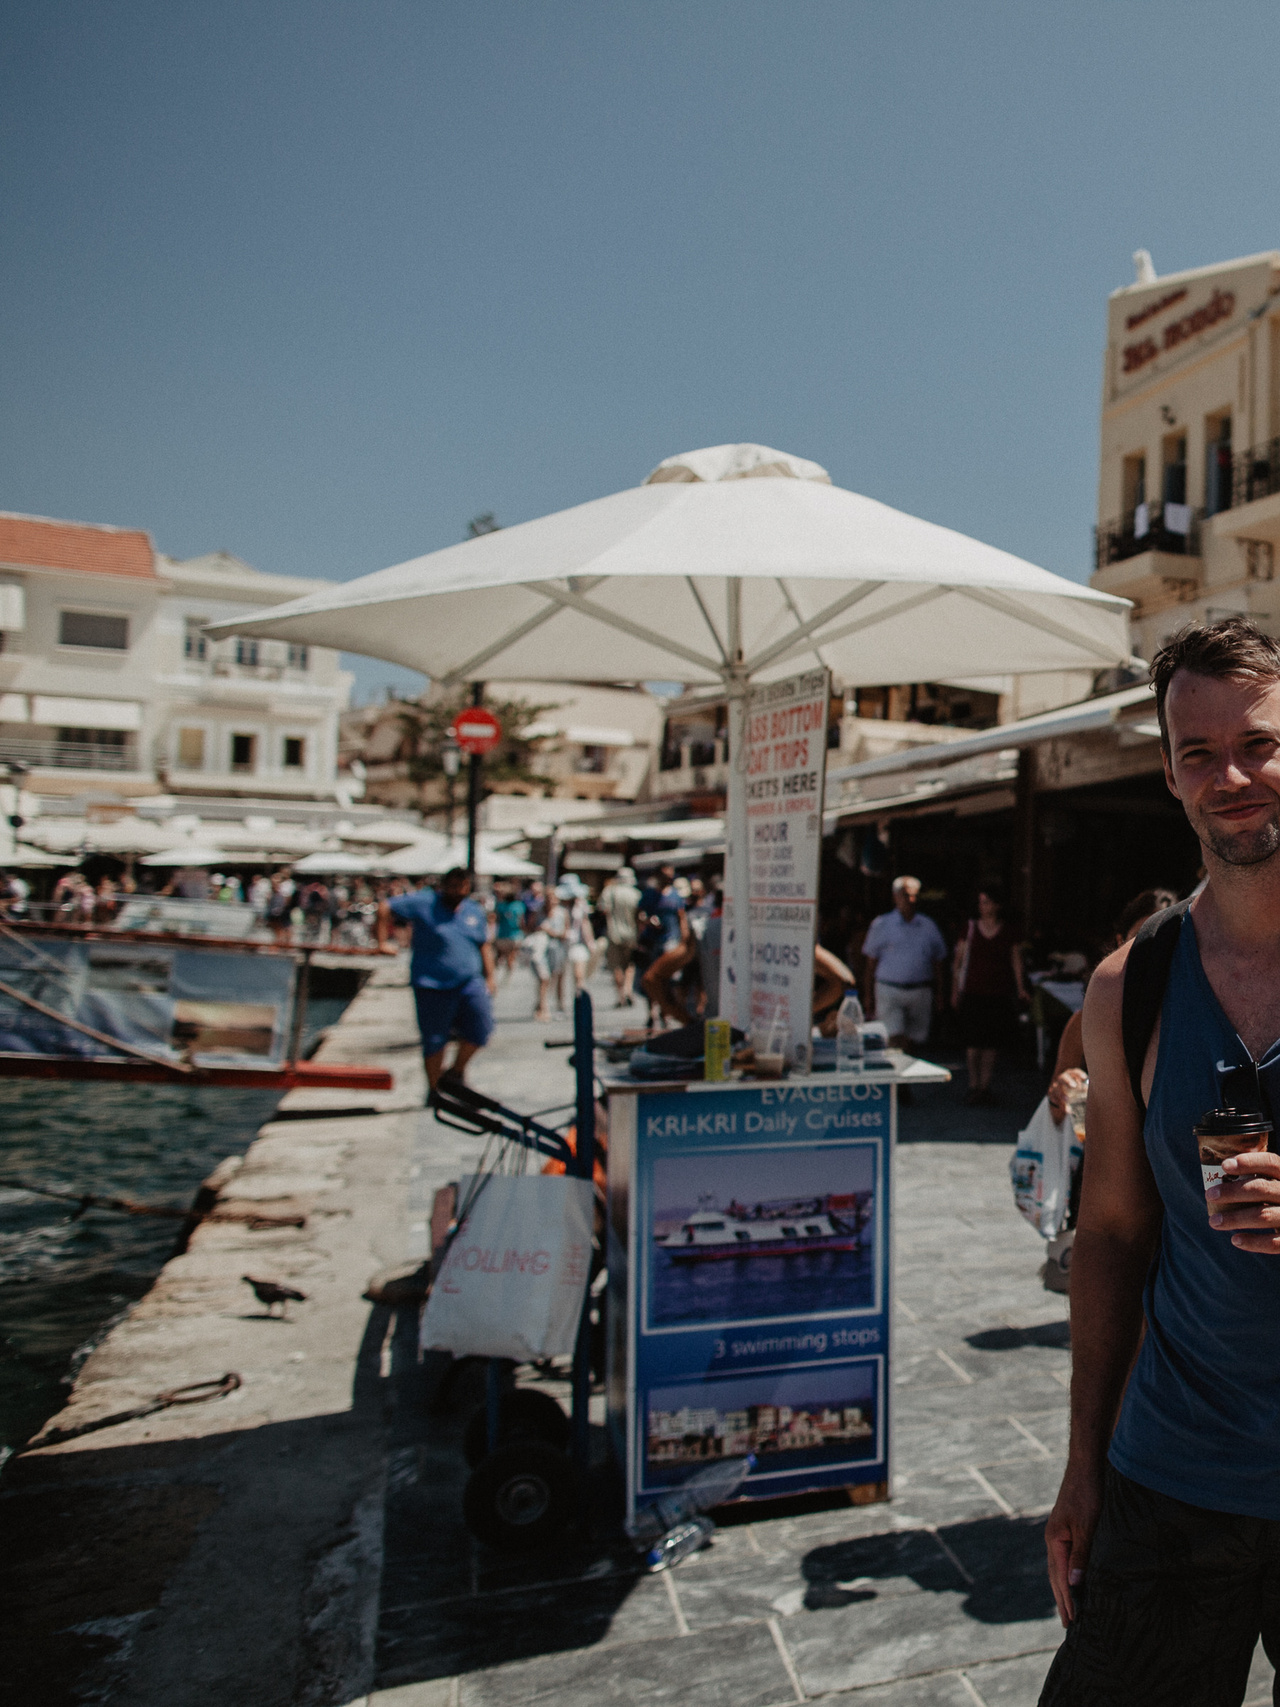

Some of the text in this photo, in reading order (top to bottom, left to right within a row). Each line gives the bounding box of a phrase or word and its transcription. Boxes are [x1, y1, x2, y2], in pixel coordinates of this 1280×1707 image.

[771, 700, 824, 739] BOTTOM
[773, 737, 809, 770] TRIPS
[782, 771, 818, 796] HERE
[754, 821, 788, 844] HOUR
[754, 943, 801, 967] HOURS
[761, 1084, 883, 1106] EVAGELOS
[647, 1108, 883, 1138] KRI-KRI Daily Cruises
[713, 1327, 880, 1359] 3 swimming stops
